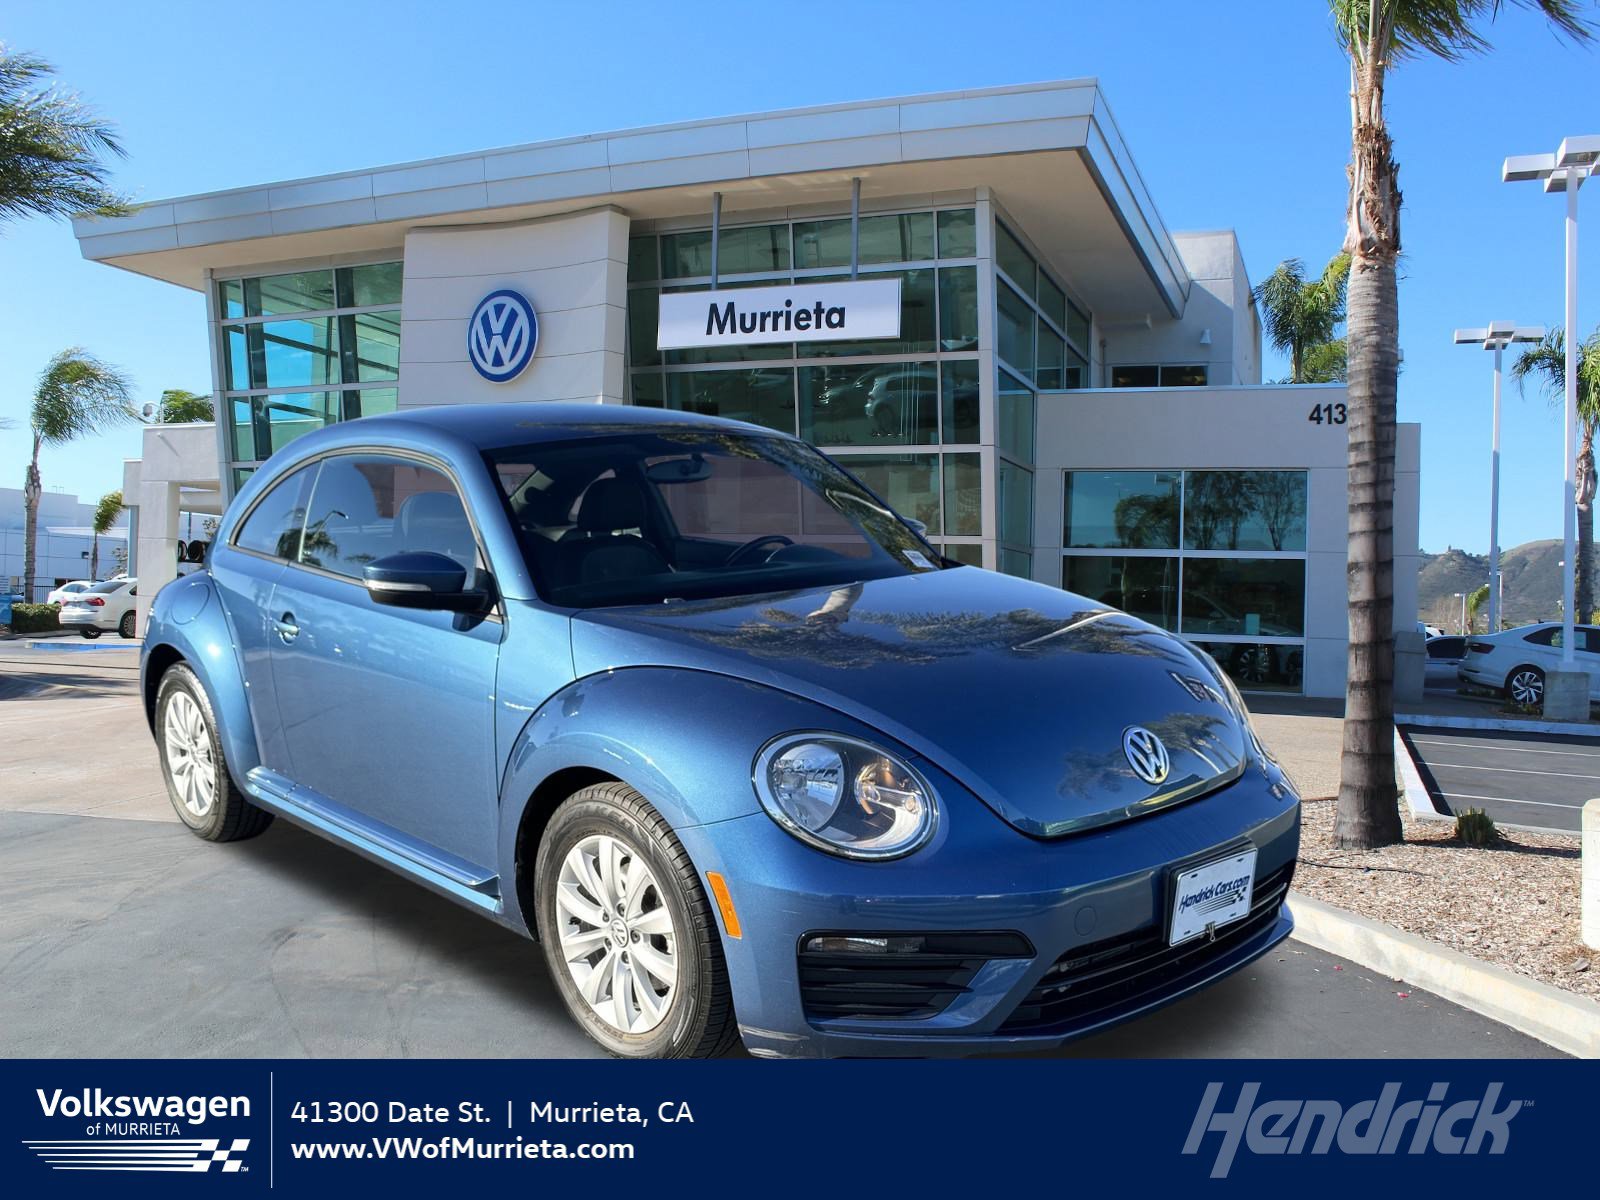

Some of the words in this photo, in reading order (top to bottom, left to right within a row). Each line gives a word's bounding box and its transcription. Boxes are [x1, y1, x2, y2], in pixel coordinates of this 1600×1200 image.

[469, 293, 535, 378] VW
[706, 299, 846, 336] Murrieta
[1308, 403, 1347, 425] 413
[1123, 727, 1168, 783] VW
